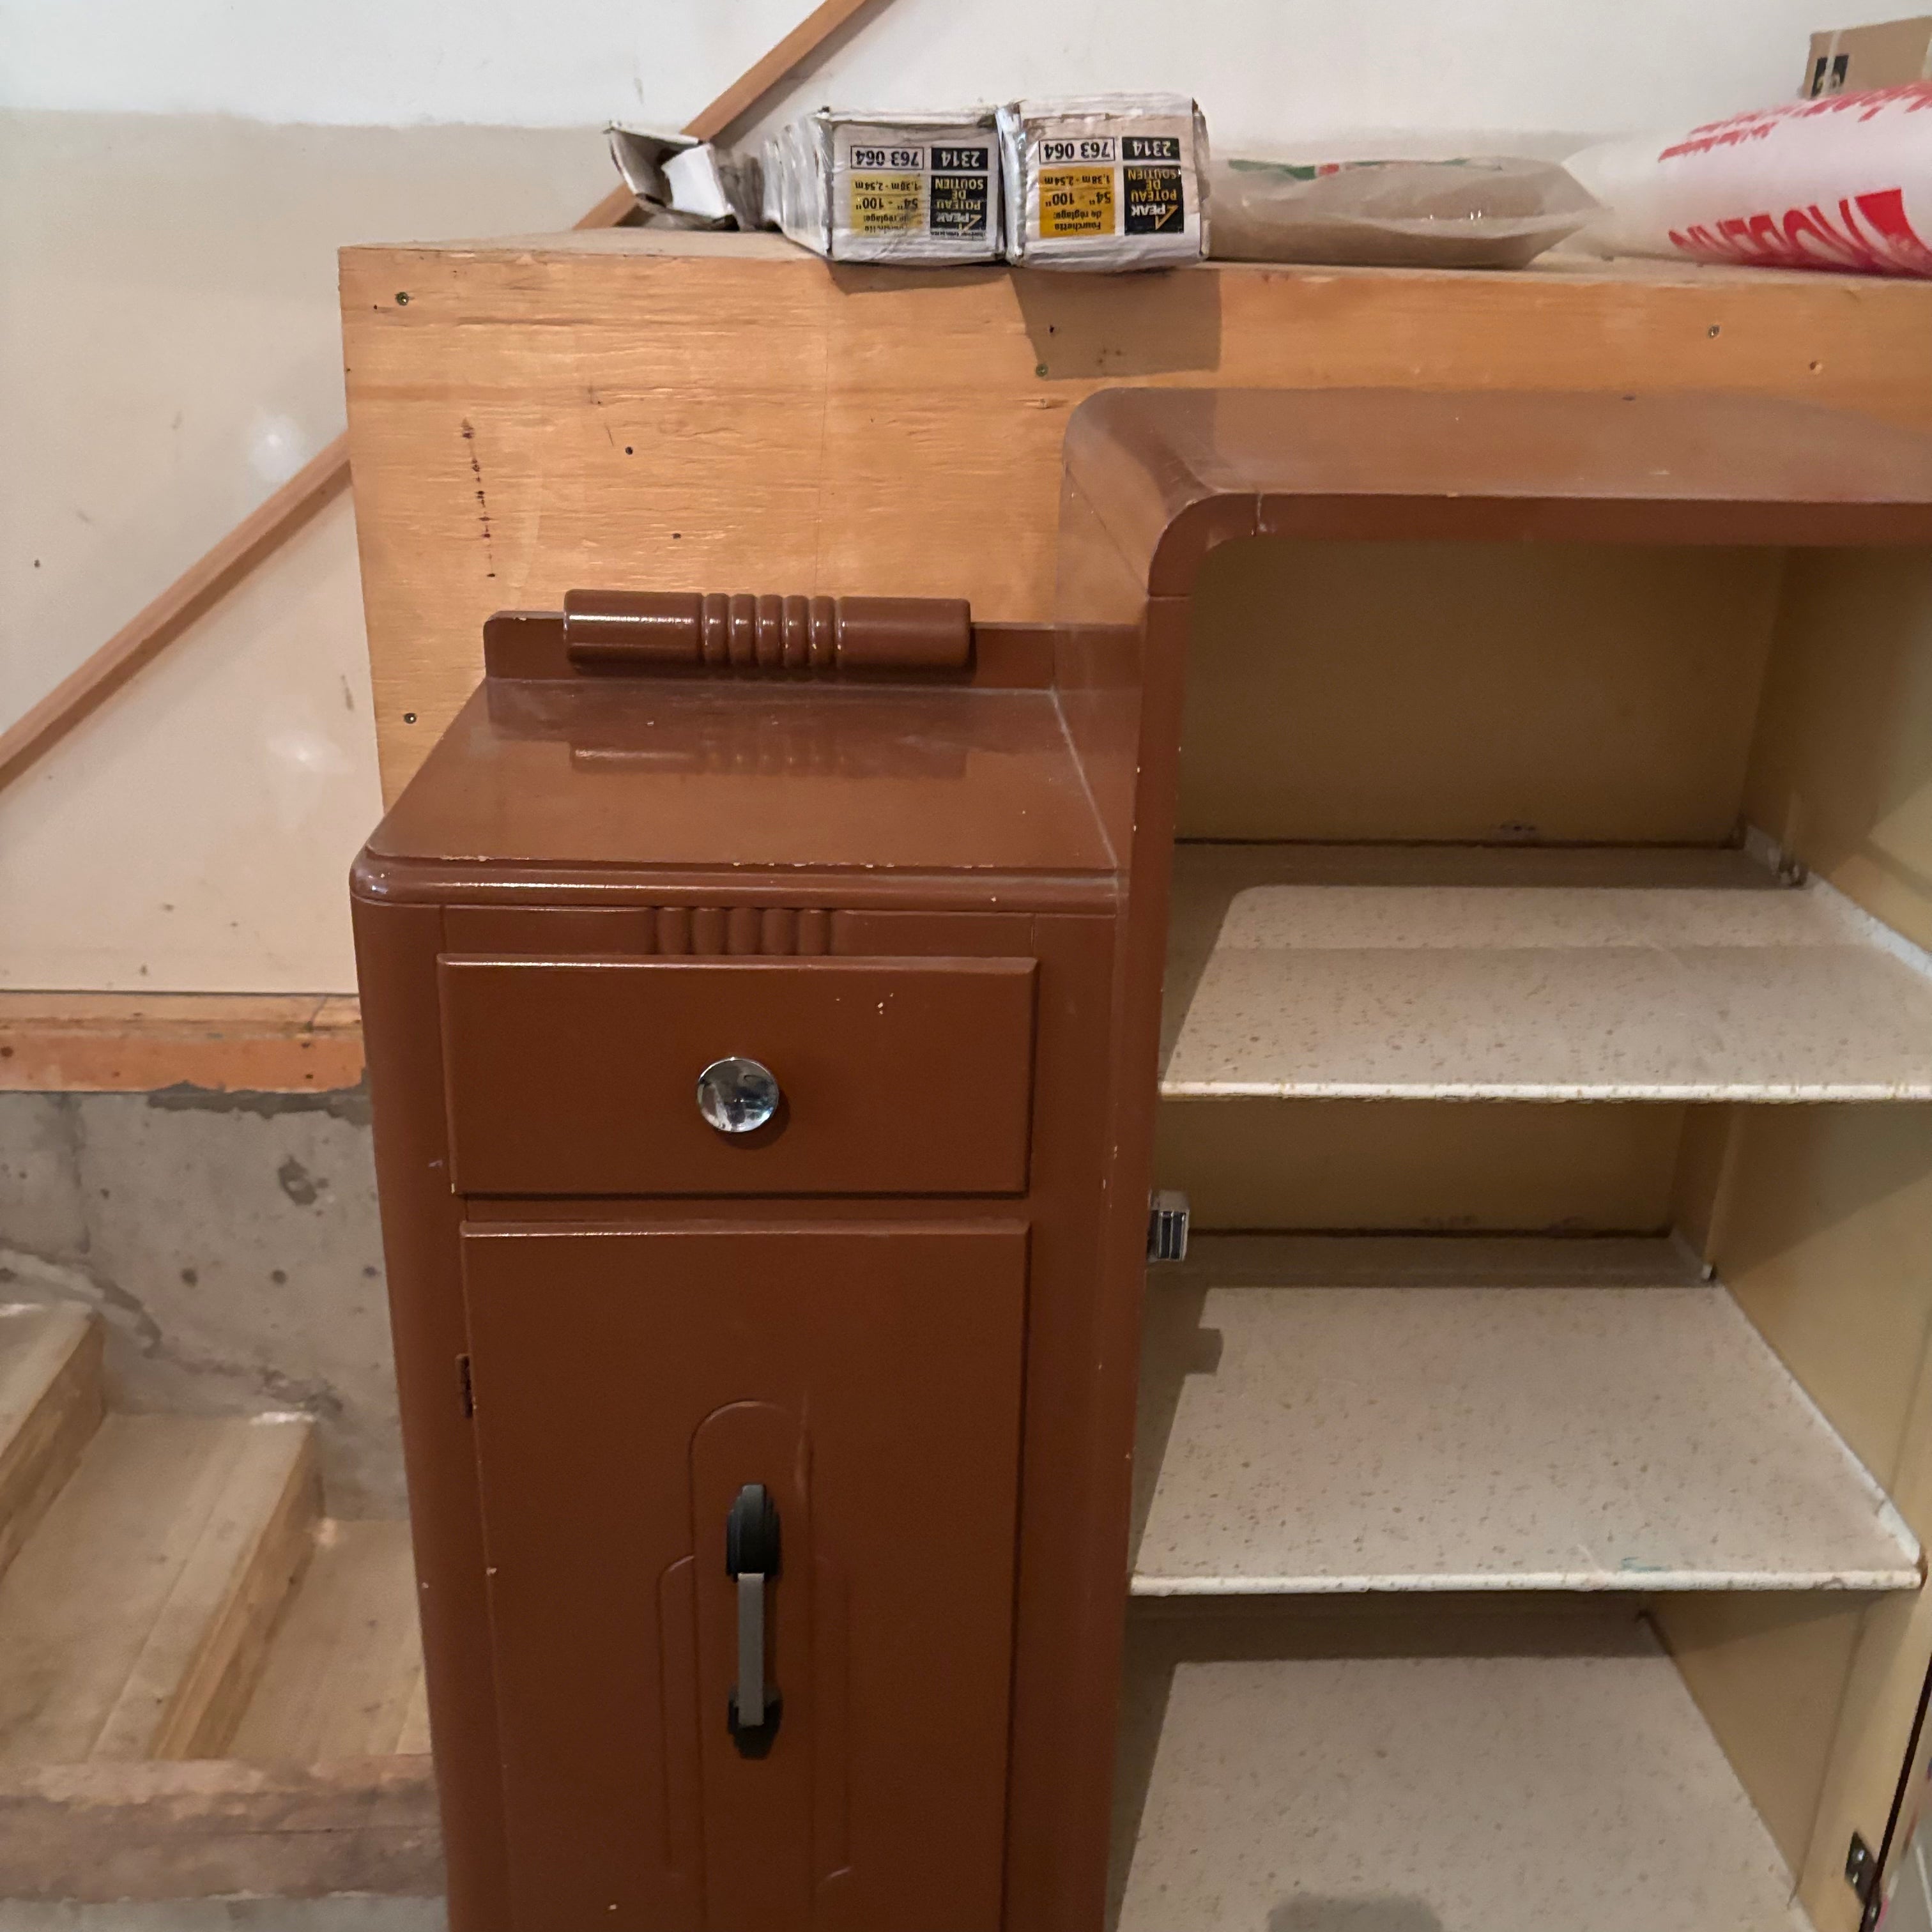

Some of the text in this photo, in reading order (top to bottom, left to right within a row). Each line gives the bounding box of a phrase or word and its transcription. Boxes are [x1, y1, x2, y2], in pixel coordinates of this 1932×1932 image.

[1043, 141, 1110, 160] 763 064
[1132, 140, 1172, 157] 2314
[855, 150, 919, 167] 763 064
[940, 150, 980, 167] 2314
[1127, 169, 1178, 181] SOUTIEN
[935, 178, 984, 190] SOUTIEN
[1145, 178, 1162, 190] DE
[951, 190, 967, 199] DE
[1130, 188, 1177, 203] POTEAU
[936, 199, 981, 211] POTEAU
[1131, 204, 1166, 218] PEAK
[936, 212, 970, 223] PEAK
